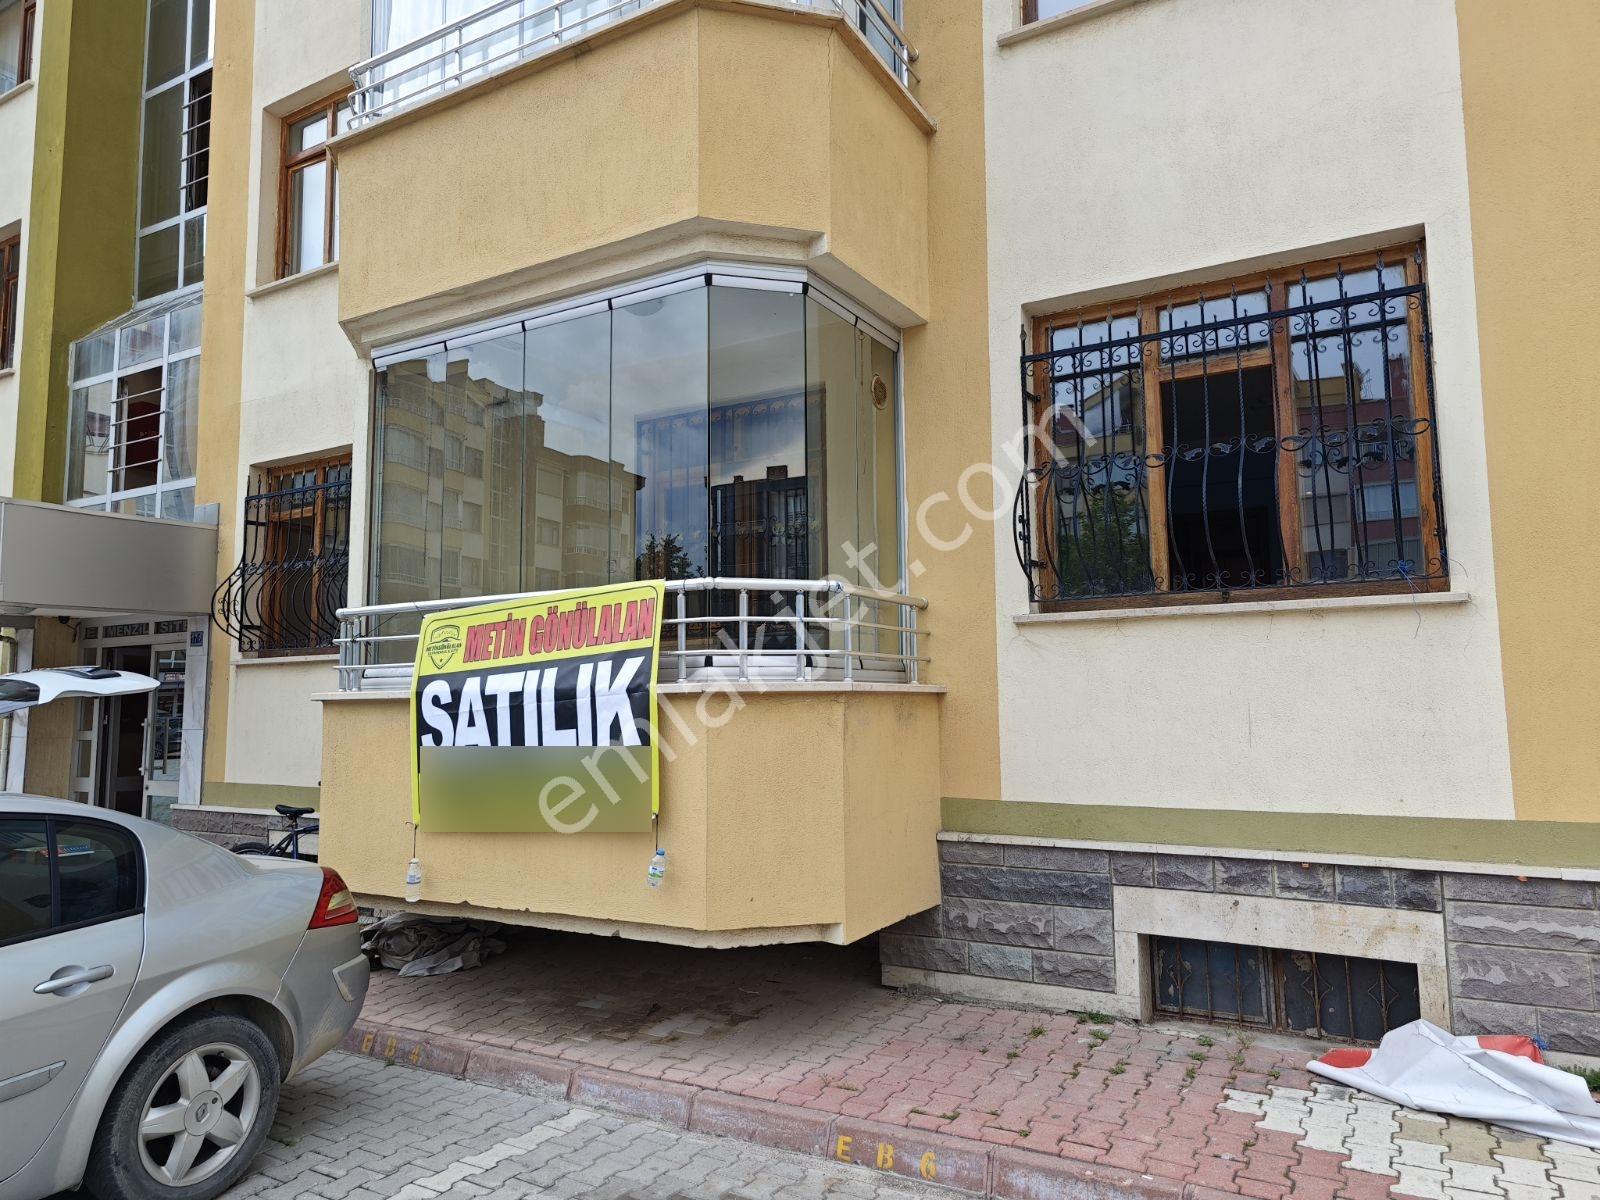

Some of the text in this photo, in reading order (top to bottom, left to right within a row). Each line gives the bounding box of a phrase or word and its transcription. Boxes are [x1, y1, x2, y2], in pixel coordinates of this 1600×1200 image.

[463, 598, 656, 663] METİN GÖNÜLALAN
[421, 656, 645, 746] SATILIK
